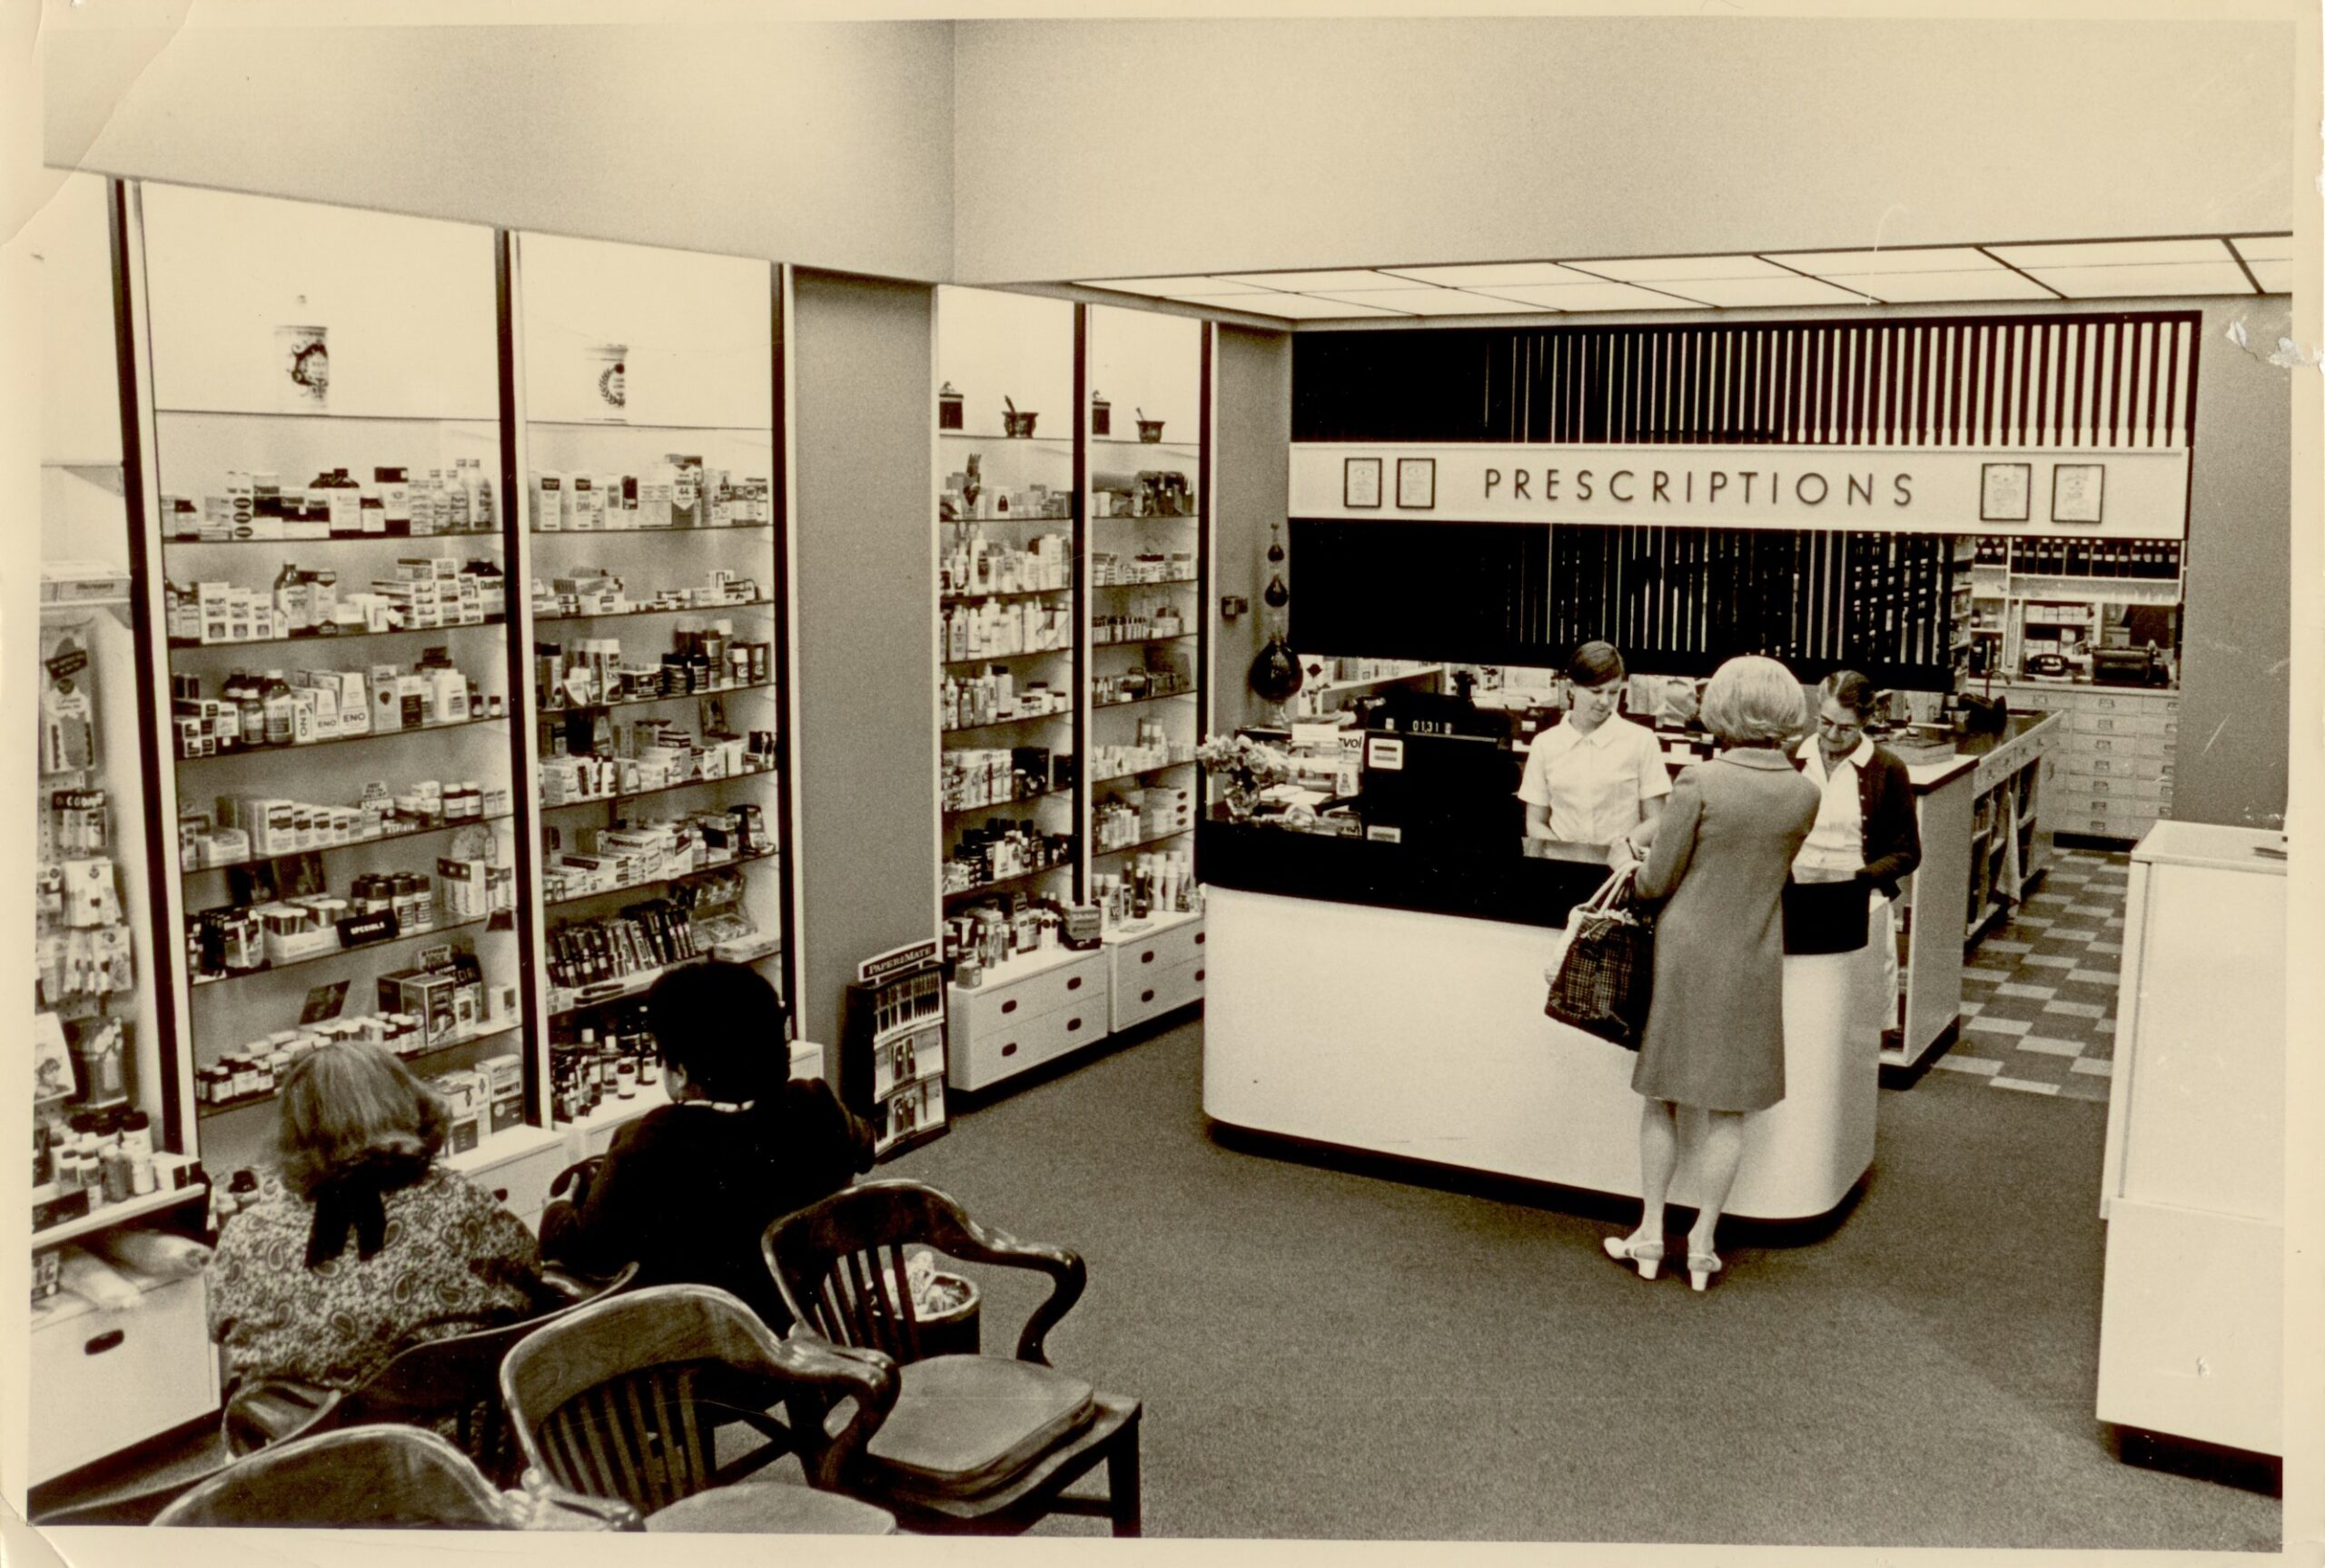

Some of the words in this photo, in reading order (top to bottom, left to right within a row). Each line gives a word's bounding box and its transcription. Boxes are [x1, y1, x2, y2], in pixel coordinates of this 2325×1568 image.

[1484, 468, 1914, 507] PRESCRIPTIONS
[299, 707, 308, 737] ENO
[317, 718, 337, 729] ENO
[342, 712, 366, 724] ENO
